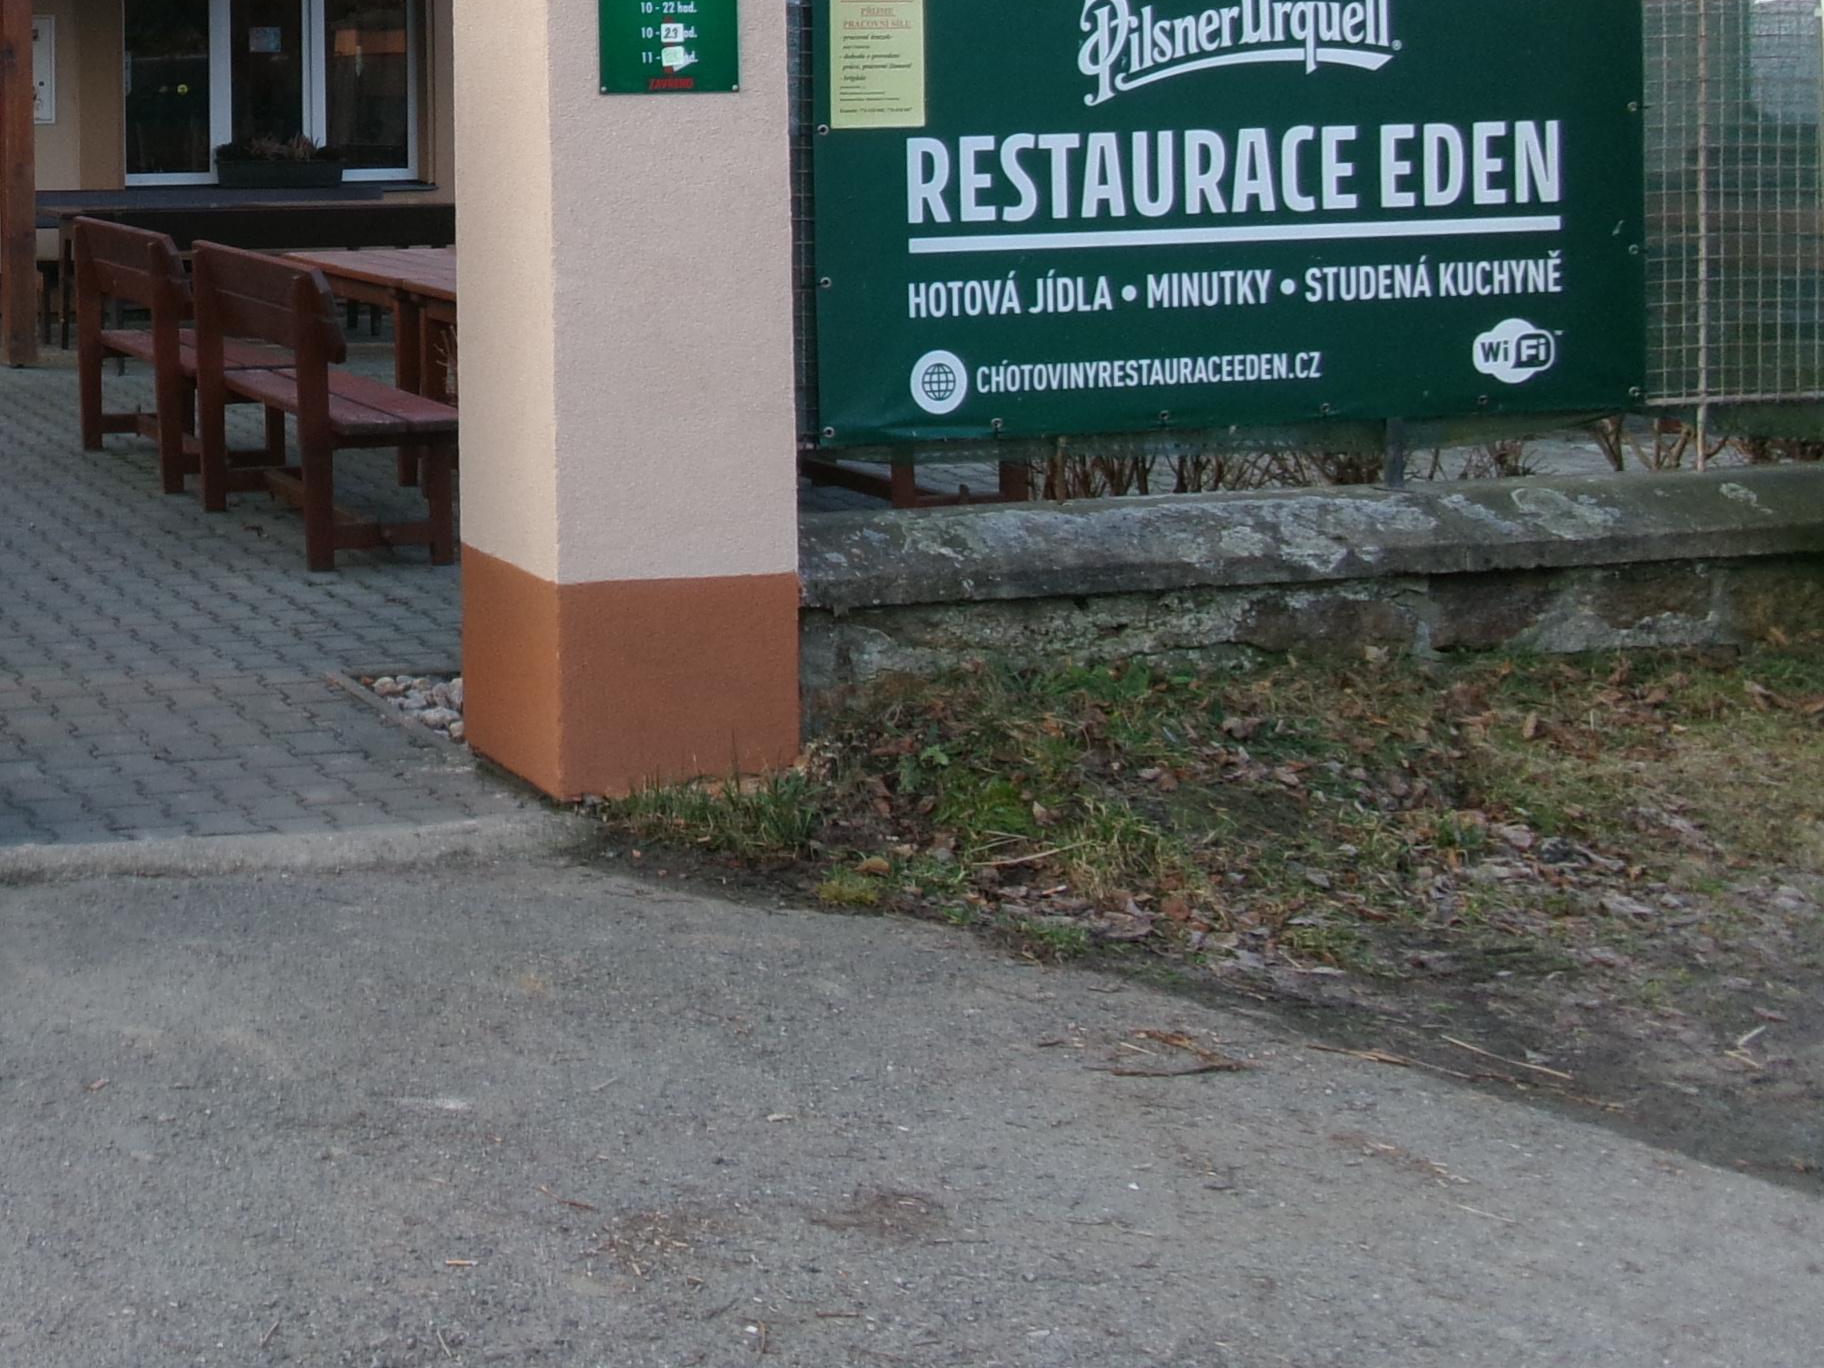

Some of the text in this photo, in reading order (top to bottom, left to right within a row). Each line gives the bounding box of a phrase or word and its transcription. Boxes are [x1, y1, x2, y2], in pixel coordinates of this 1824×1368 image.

[640, 2, 653, 13] 10
[662, 2, 675, 13] 22
[641, 27, 653, 39] 10
[641, 51, 652, 64] 11
[906, 120, 1560, 224] RESTAURACE EDEN
[908, 250, 1563, 319] HOTOVÁ JÍDLA MINUTKY STUDENÁ KUCHYNĚ
[976, 351, 1323, 393] CHOTOVINYRESTAURACEEDEN.CZ
